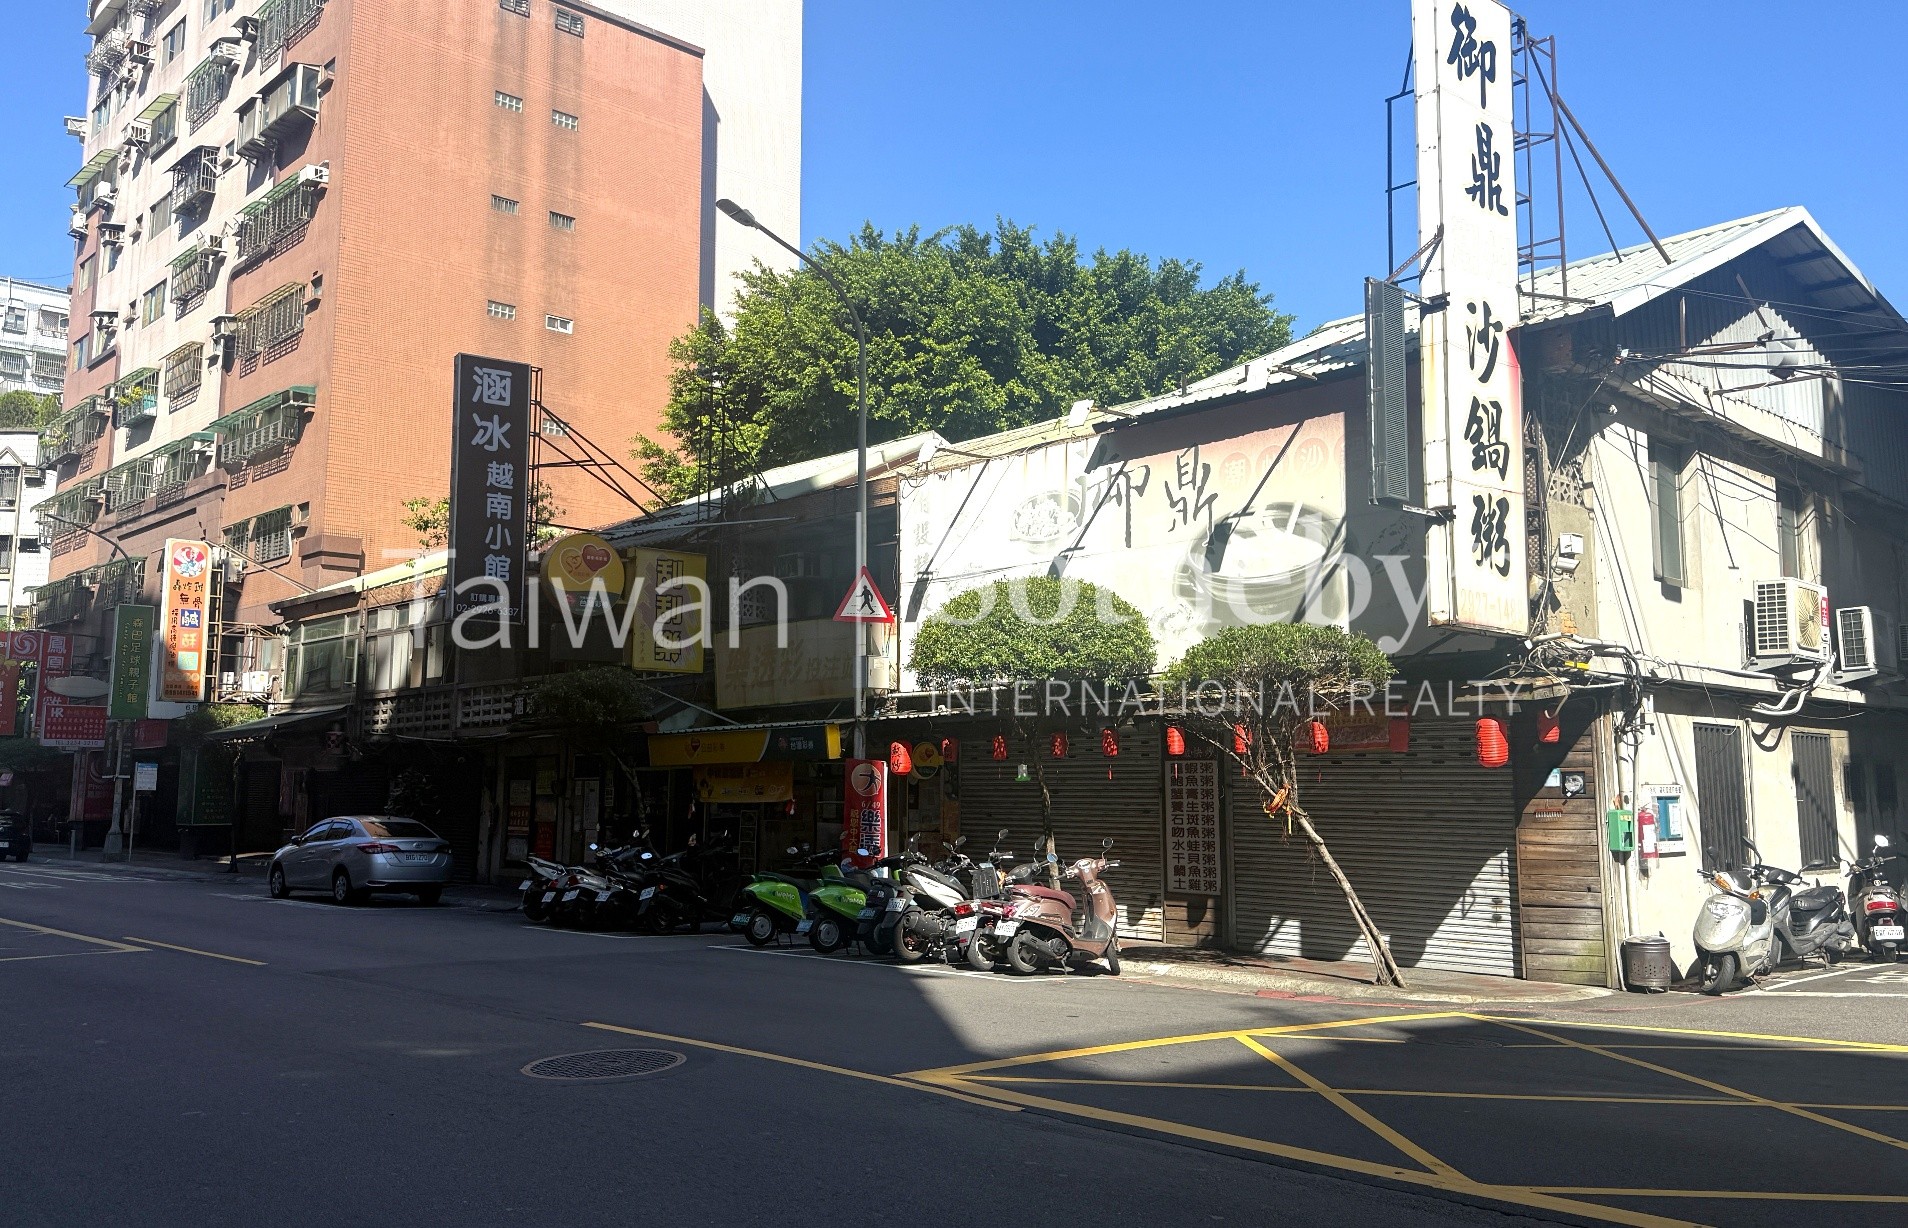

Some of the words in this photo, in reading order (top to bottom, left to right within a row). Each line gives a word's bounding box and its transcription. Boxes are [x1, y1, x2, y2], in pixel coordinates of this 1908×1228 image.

[1447, 2, 1509, 217] 御鼎
[471, 365, 513, 452] 涵冰
[1463, 299, 1511, 579] 沙鍋粥
[1075, 441, 1219, 549] 御鼎
[483, 461, 514, 583] 越南小館
[655, 558, 684, 664] 刮刮樂
[861, 800, 881, 809] 6/49
[1171, 801, 1215, 813] 養生粥
[1172, 814, 1215, 826] 石斑粥
[1172, 827, 1216, 839] 吻魚粥
[1172, 840, 1216, 853] 水蛙粥
[1172, 853, 1216, 866] 干貝粥
[1173, 878, 1218, 892] 土雞粥
